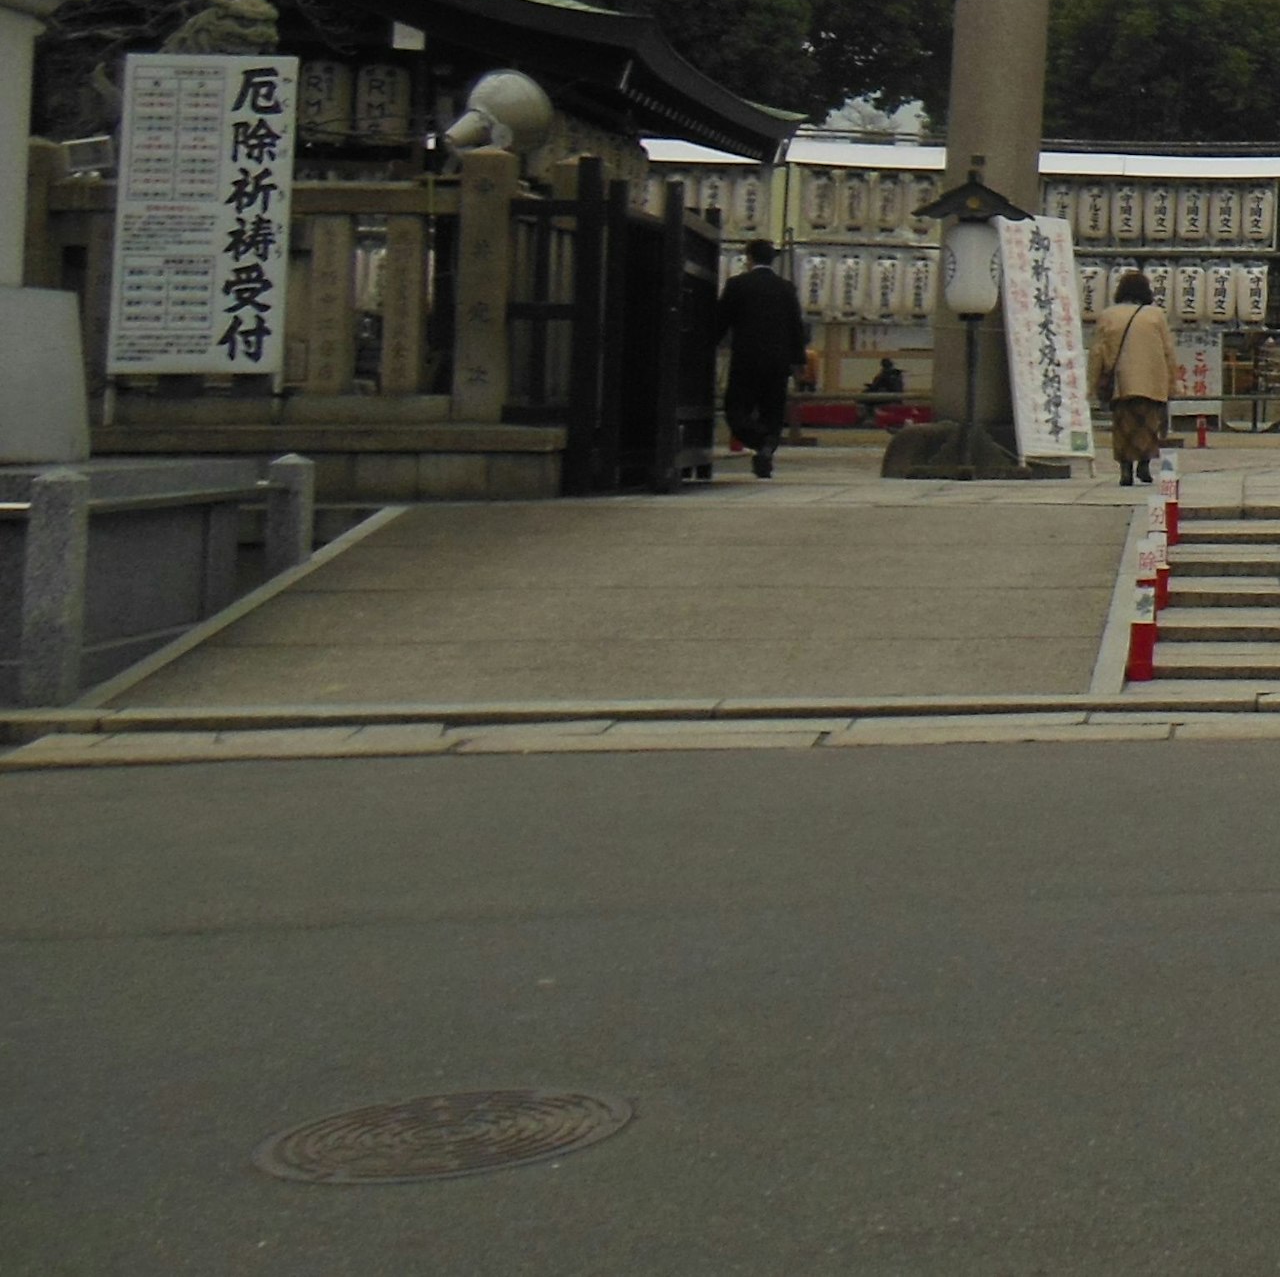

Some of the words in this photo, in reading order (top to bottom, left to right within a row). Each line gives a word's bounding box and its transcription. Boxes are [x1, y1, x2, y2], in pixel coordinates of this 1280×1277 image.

[216, 67, 284, 363] 厄除祈祷受付
